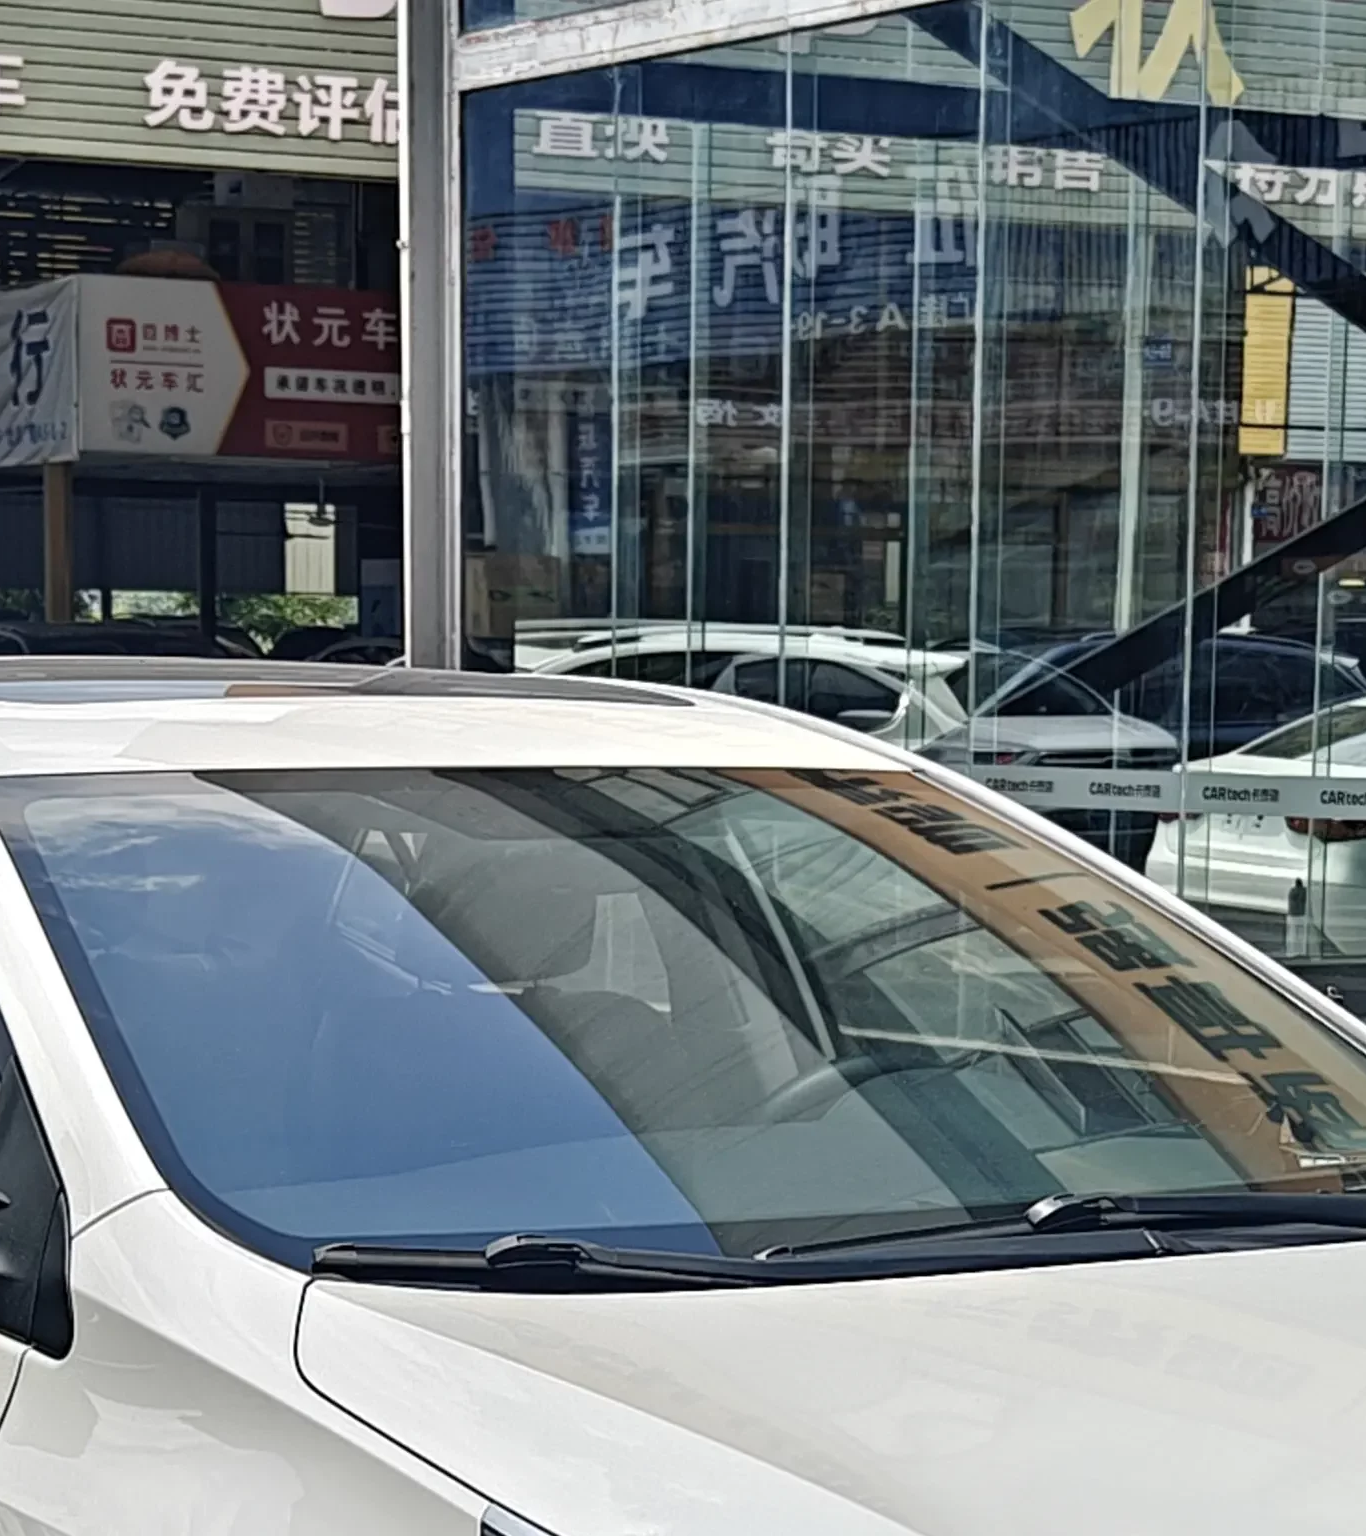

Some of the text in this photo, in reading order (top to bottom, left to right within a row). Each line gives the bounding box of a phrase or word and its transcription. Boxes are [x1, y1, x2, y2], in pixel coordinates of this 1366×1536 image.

[262, 300, 398, 350] 状元车
[109, 368, 205, 393] 状元车汇
